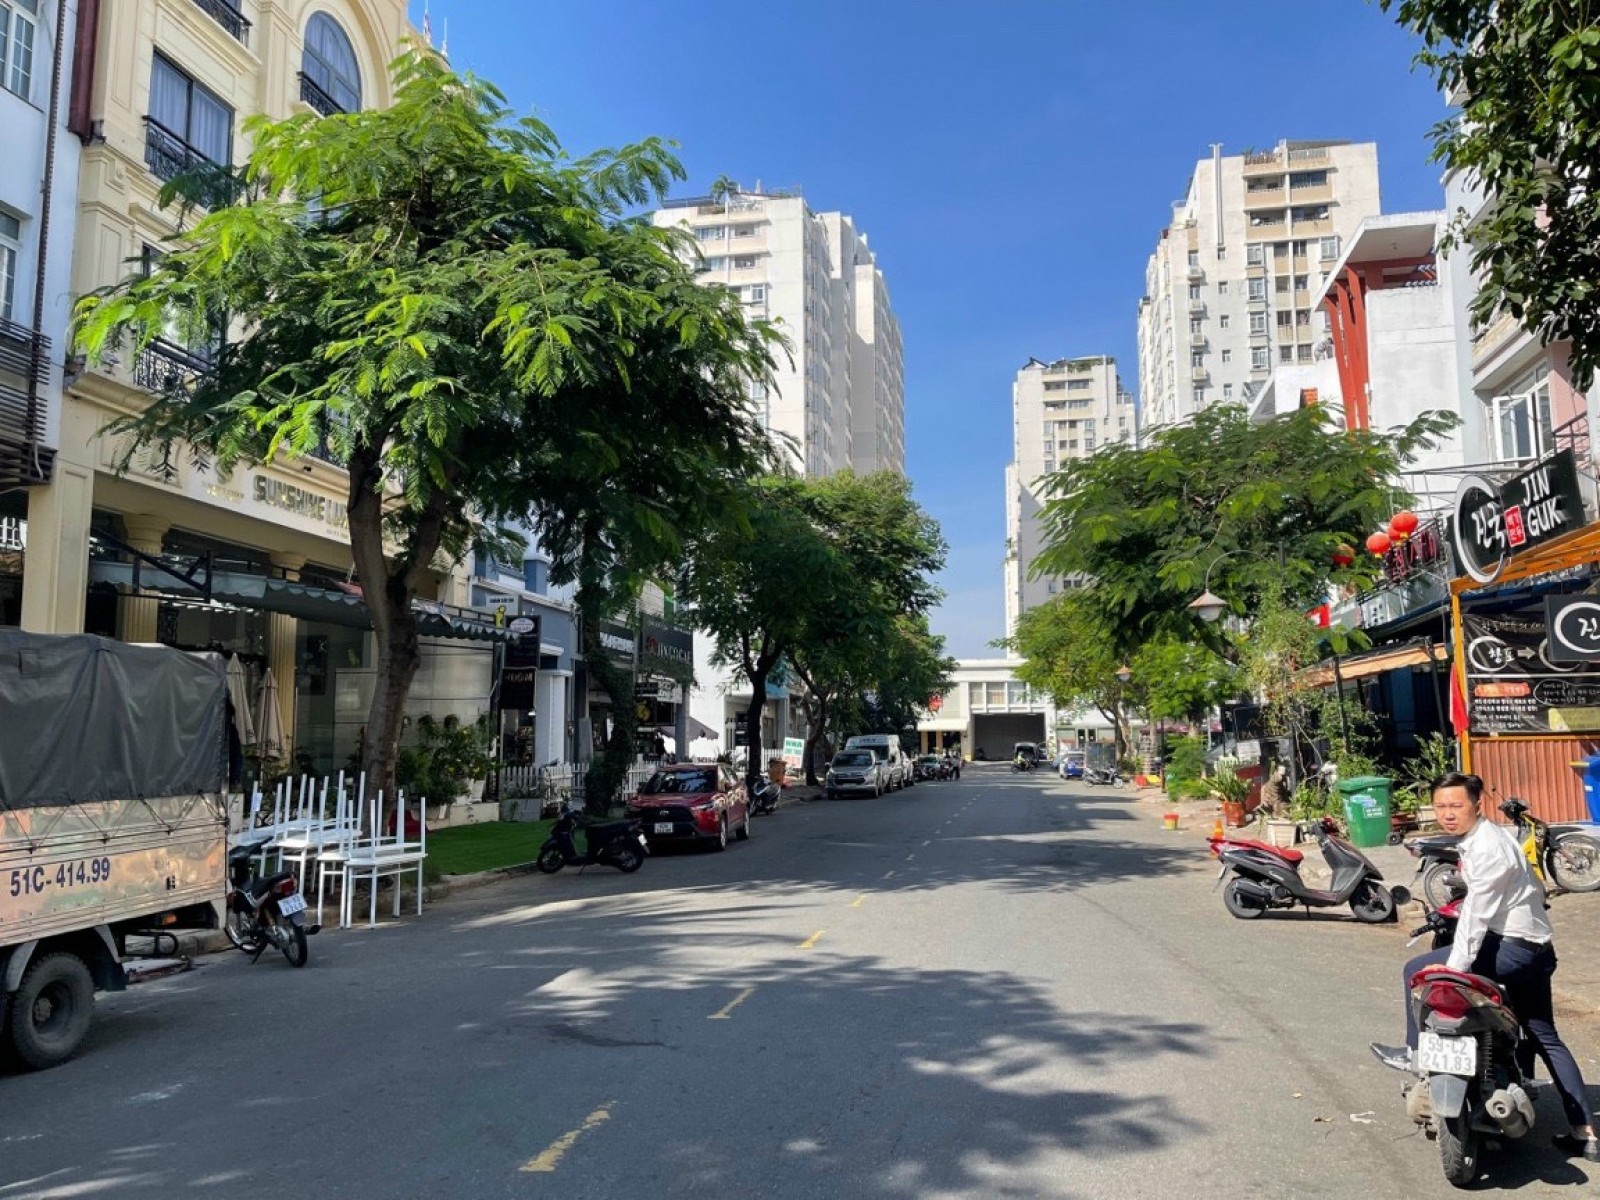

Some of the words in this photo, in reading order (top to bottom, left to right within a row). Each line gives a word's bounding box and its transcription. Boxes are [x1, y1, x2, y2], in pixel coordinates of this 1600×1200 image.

[253, 474, 326, 521] SUNSHINE
[1521, 467, 1550, 507] JIN
[1528, 497, 1561, 536] GUK
[10, 857, 110, 897] 51C-414.99
[1423, 1053, 1472, 1072] 241.83
[1428, 1037, 1467, 1055] 59-C2
